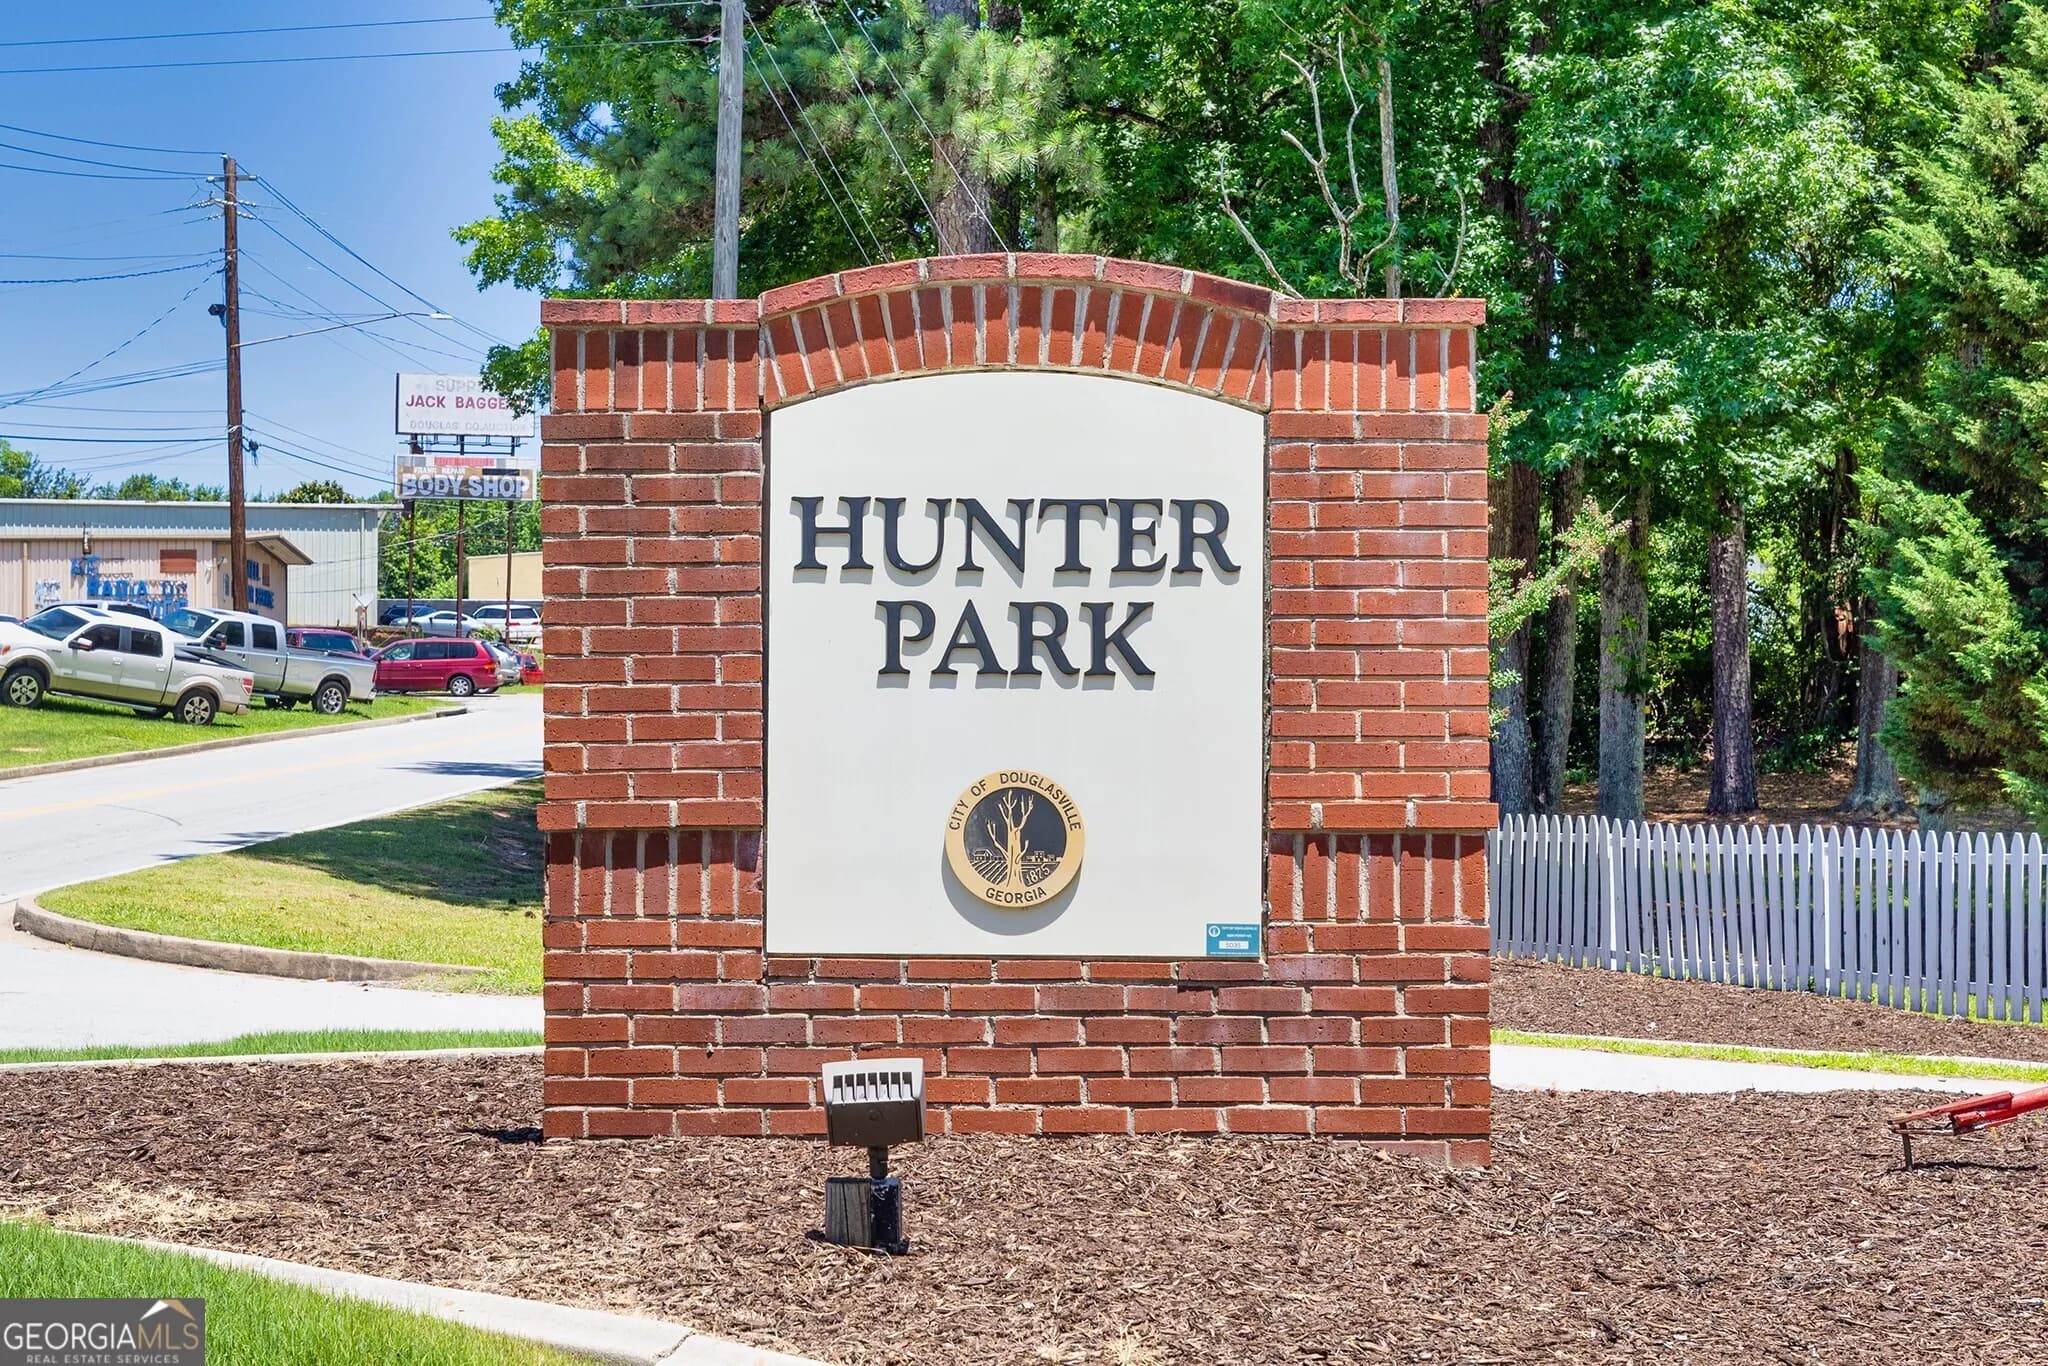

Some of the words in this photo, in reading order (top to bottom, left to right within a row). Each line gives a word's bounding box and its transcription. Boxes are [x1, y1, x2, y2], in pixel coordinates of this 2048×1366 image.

[406, 395, 446, 408] JACK
[456, 396, 512, 410] BAGGE
[409, 420, 459, 430] DOUGLAS
[401, 473, 465, 497] BODY
[468, 475, 531, 498] SHOP
[790, 496, 1241, 575] HUNTER
[876, 599, 1155, 676] PARK
[949, 799, 970, 831] CITY
[970, 779, 987, 797] OF
[999, 771, 1082, 832] DOUGLASVILLE
[1025, 864, 1051, 886] 1875
[985, 886, 1047, 904] GEORGIA
